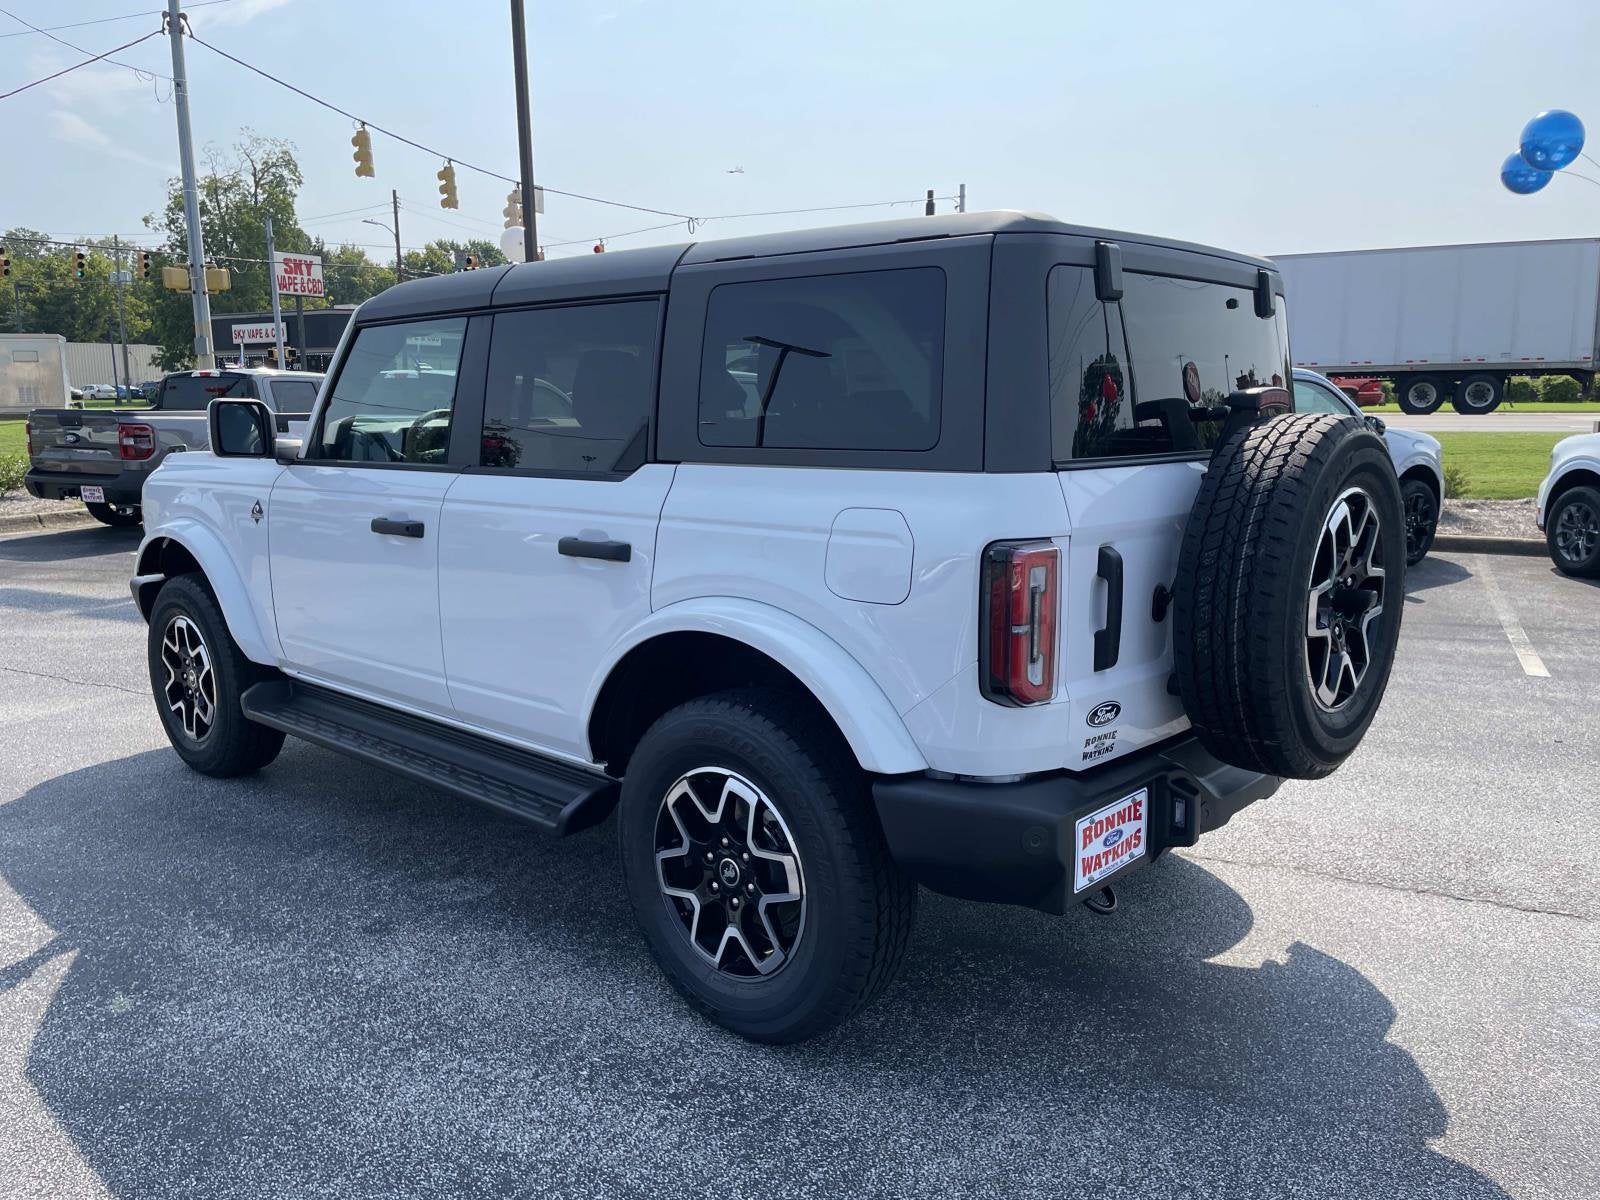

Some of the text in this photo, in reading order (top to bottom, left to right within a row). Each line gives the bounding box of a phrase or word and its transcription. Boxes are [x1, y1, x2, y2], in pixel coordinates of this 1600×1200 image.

[283, 258, 313, 276] SKY
[277, 274, 323, 294] VAPE & CBD
[233, 329, 246, 340] SKY
[247, 328, 263, 339] VAPE
[264, 328, 270, 338] &
[1095, 705, 1118, 724] Ford
[1084, 730, 1118, 748] RONNIE
[1082, 743, 1115, 761] WATKINS
[1082, 800, 1143, 850] RONNIE
[1082, 828, 1142, 877] WATKINS
